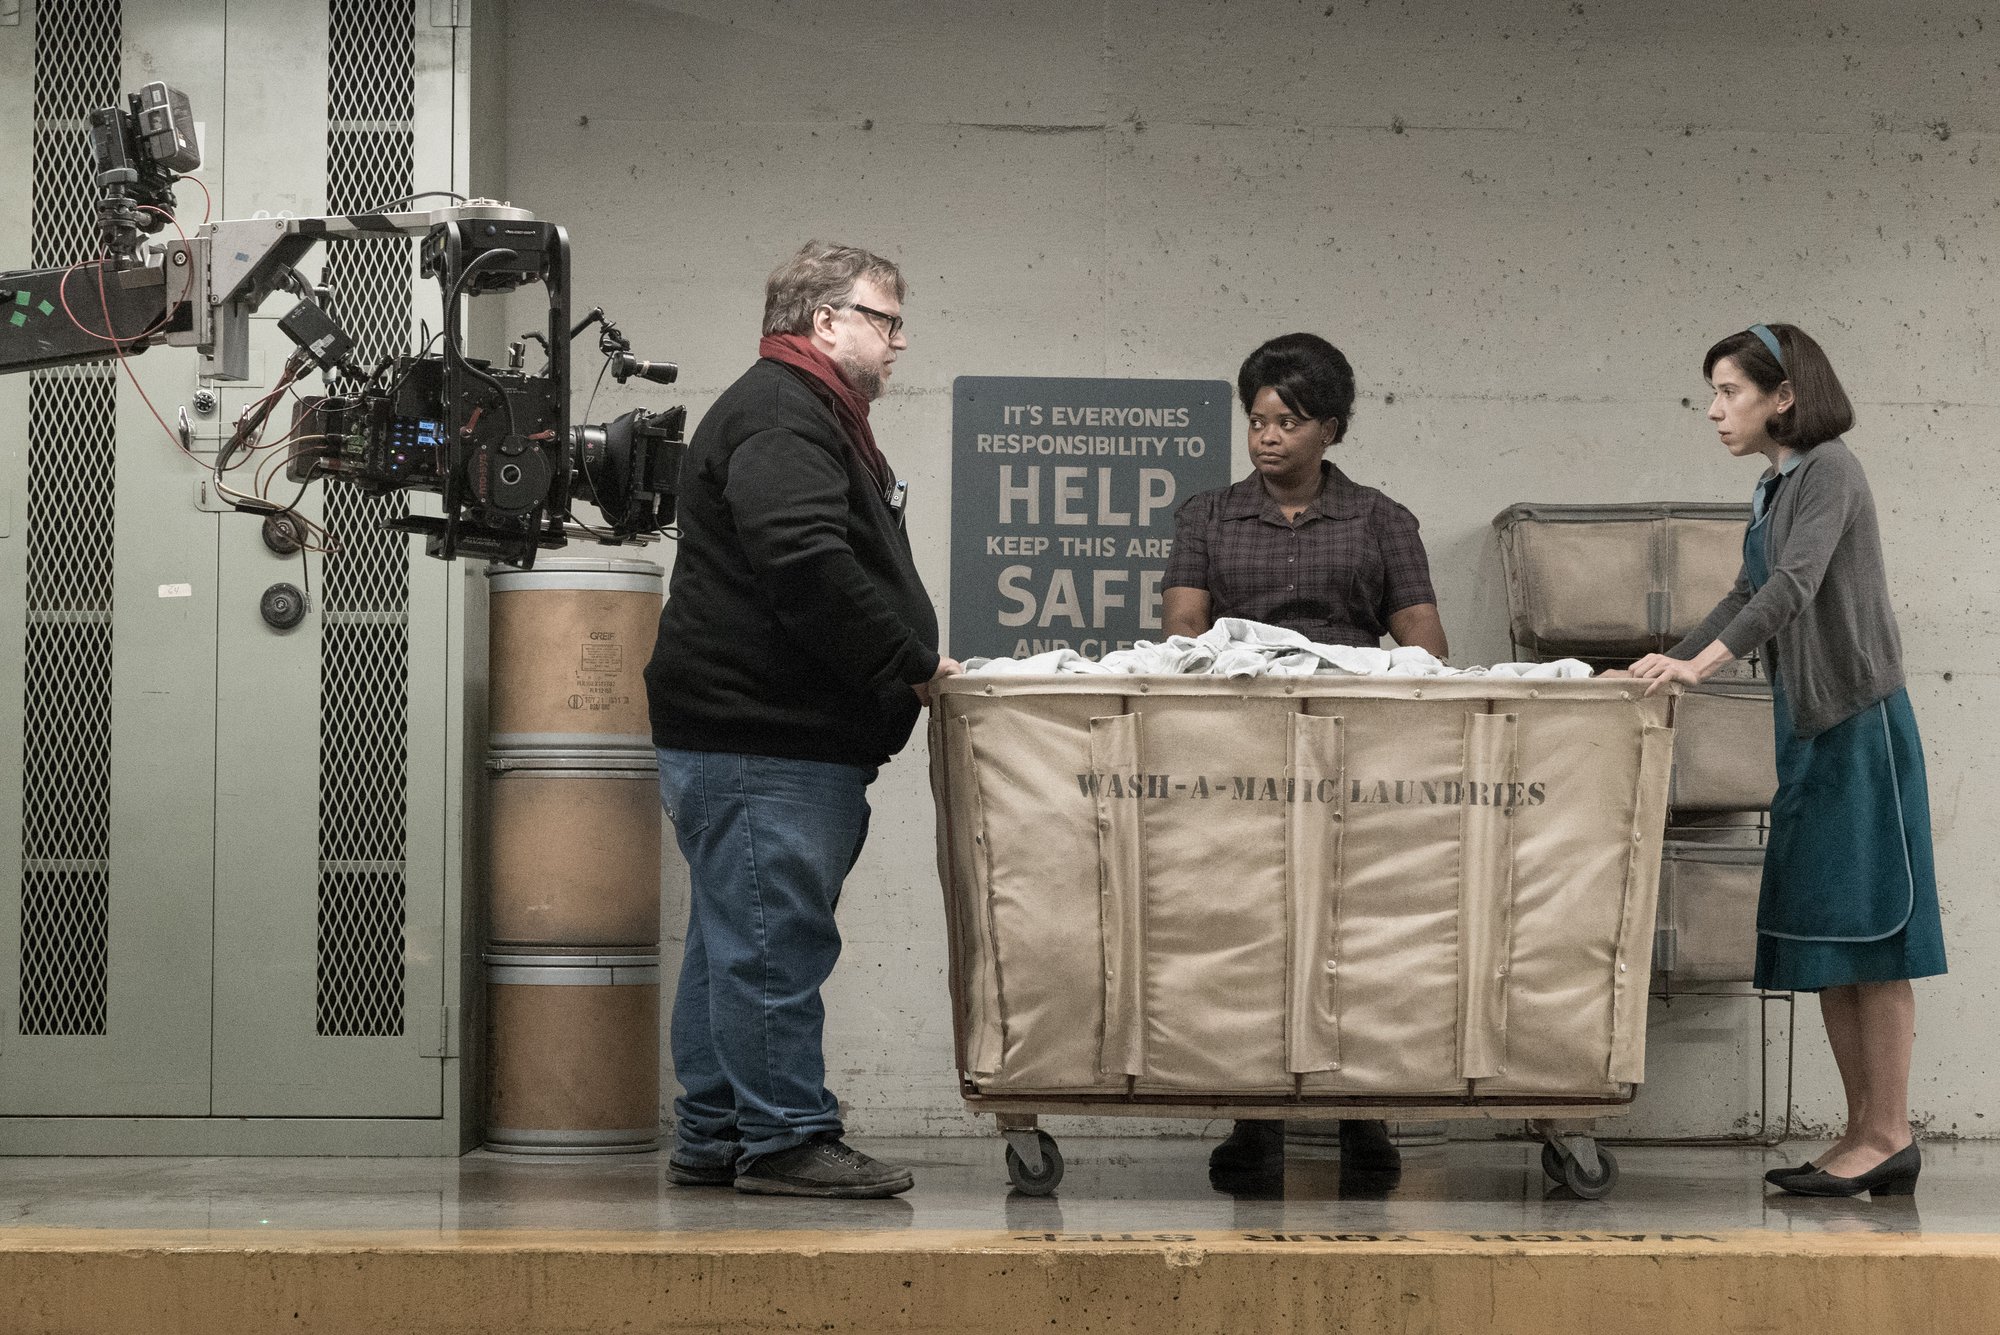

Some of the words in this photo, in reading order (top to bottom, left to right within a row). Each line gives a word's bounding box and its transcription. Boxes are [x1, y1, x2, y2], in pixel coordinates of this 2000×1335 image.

[1003, 405, 1043, 426] IT'S
[1051, 406, 1190, 427] EVERYONES
[976, 433, 1168, 457] RESPONSIBILITY
[1173, 436, 1206, 458] TO
[998, 465, 1177, 526] HELP
[985, 535, 1050, 556] KEEP
[1058, 536, 1116, 558] THIS
[1125, 538, 1174, 559] ARE
[997, 564, 1166, 630] SAFE
[589, 631, 616, 641] GREIF
[1076, 773, 1336, 804] WASH-A-MATIC
[1350, 779, 1547, 807] LAUNDRIES
